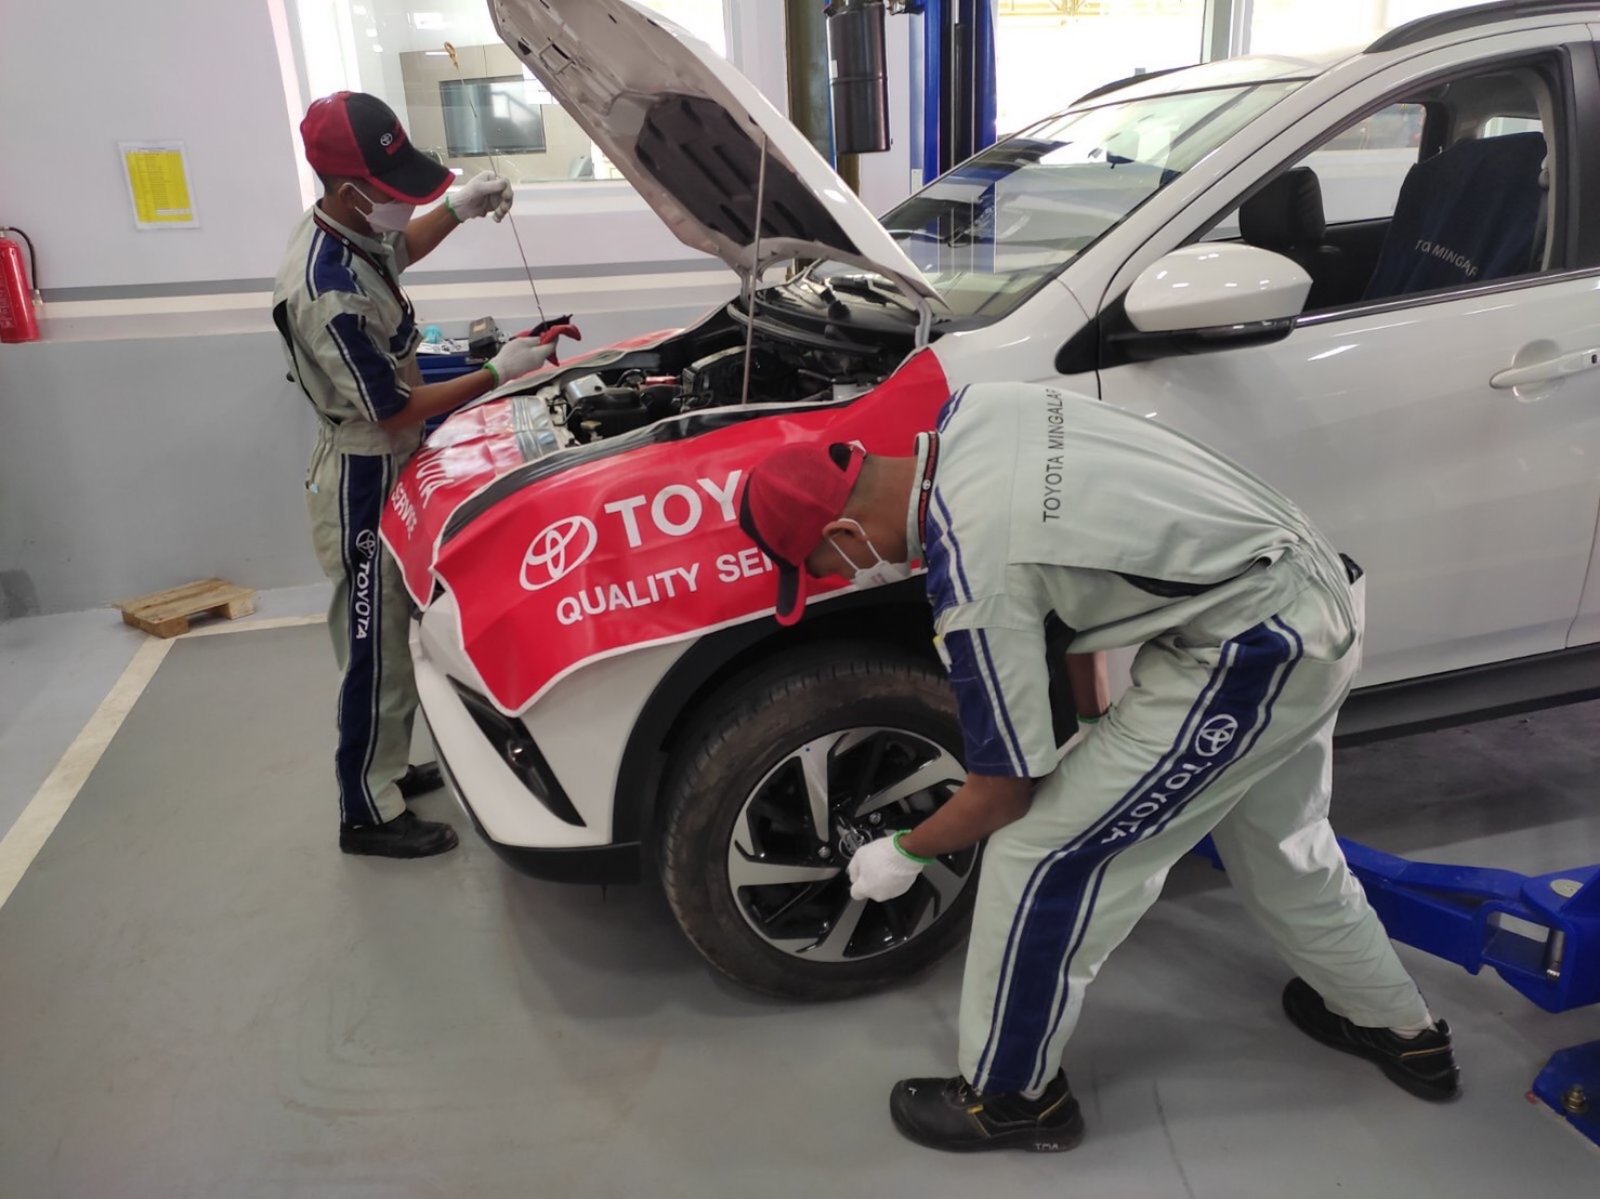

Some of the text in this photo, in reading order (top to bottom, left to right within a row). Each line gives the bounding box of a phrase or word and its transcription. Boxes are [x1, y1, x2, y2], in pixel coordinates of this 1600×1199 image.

[605, 470, 742, 549] TOY
[1043, 455, 1064, 523] TOYOTA
[355, 561, 371, 640] TOYOTA
[556, 563, 699, 625] QUALITY
[1101, 762, 1213, 844] TOYOTA
